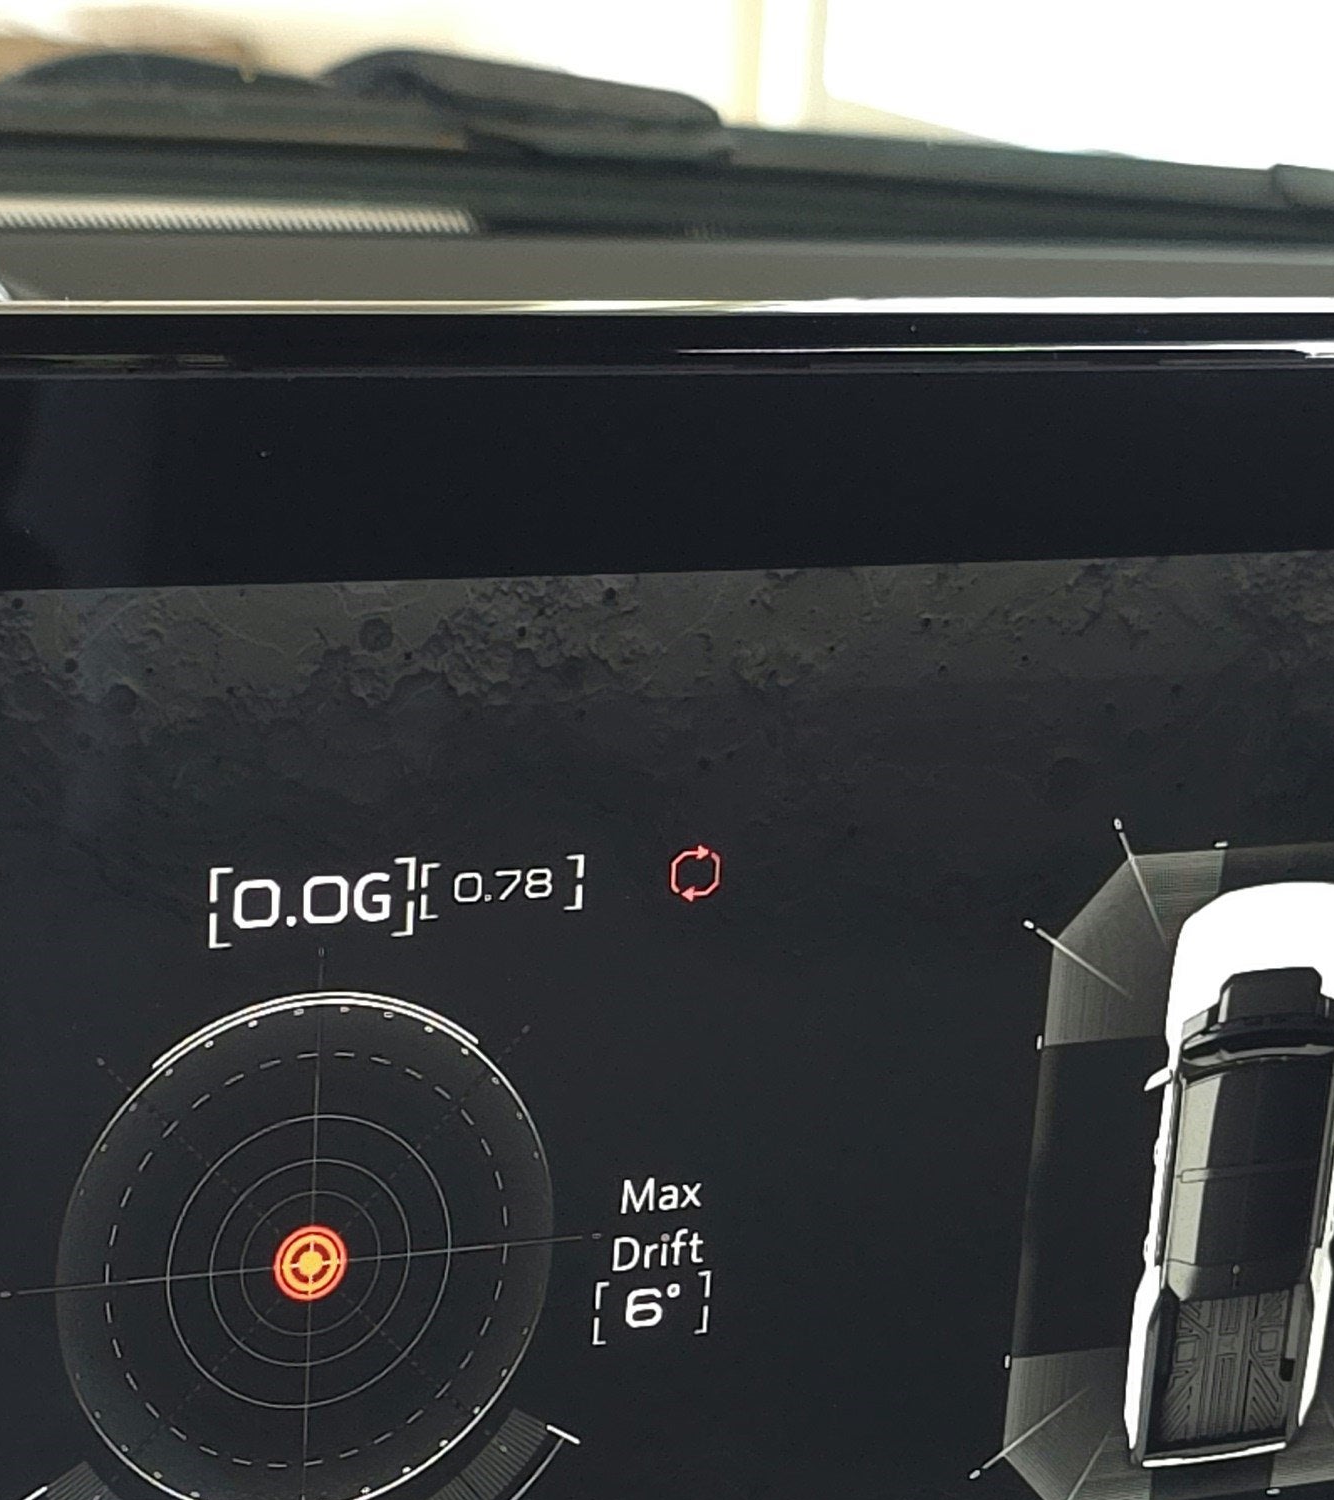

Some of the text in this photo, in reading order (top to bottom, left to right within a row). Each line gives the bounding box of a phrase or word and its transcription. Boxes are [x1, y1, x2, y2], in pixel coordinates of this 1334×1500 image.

[453, 867, 554, 904] 0.78
[619, 1177, 703, 1214] Max
[611, 1233, 705, 1274] Drift
